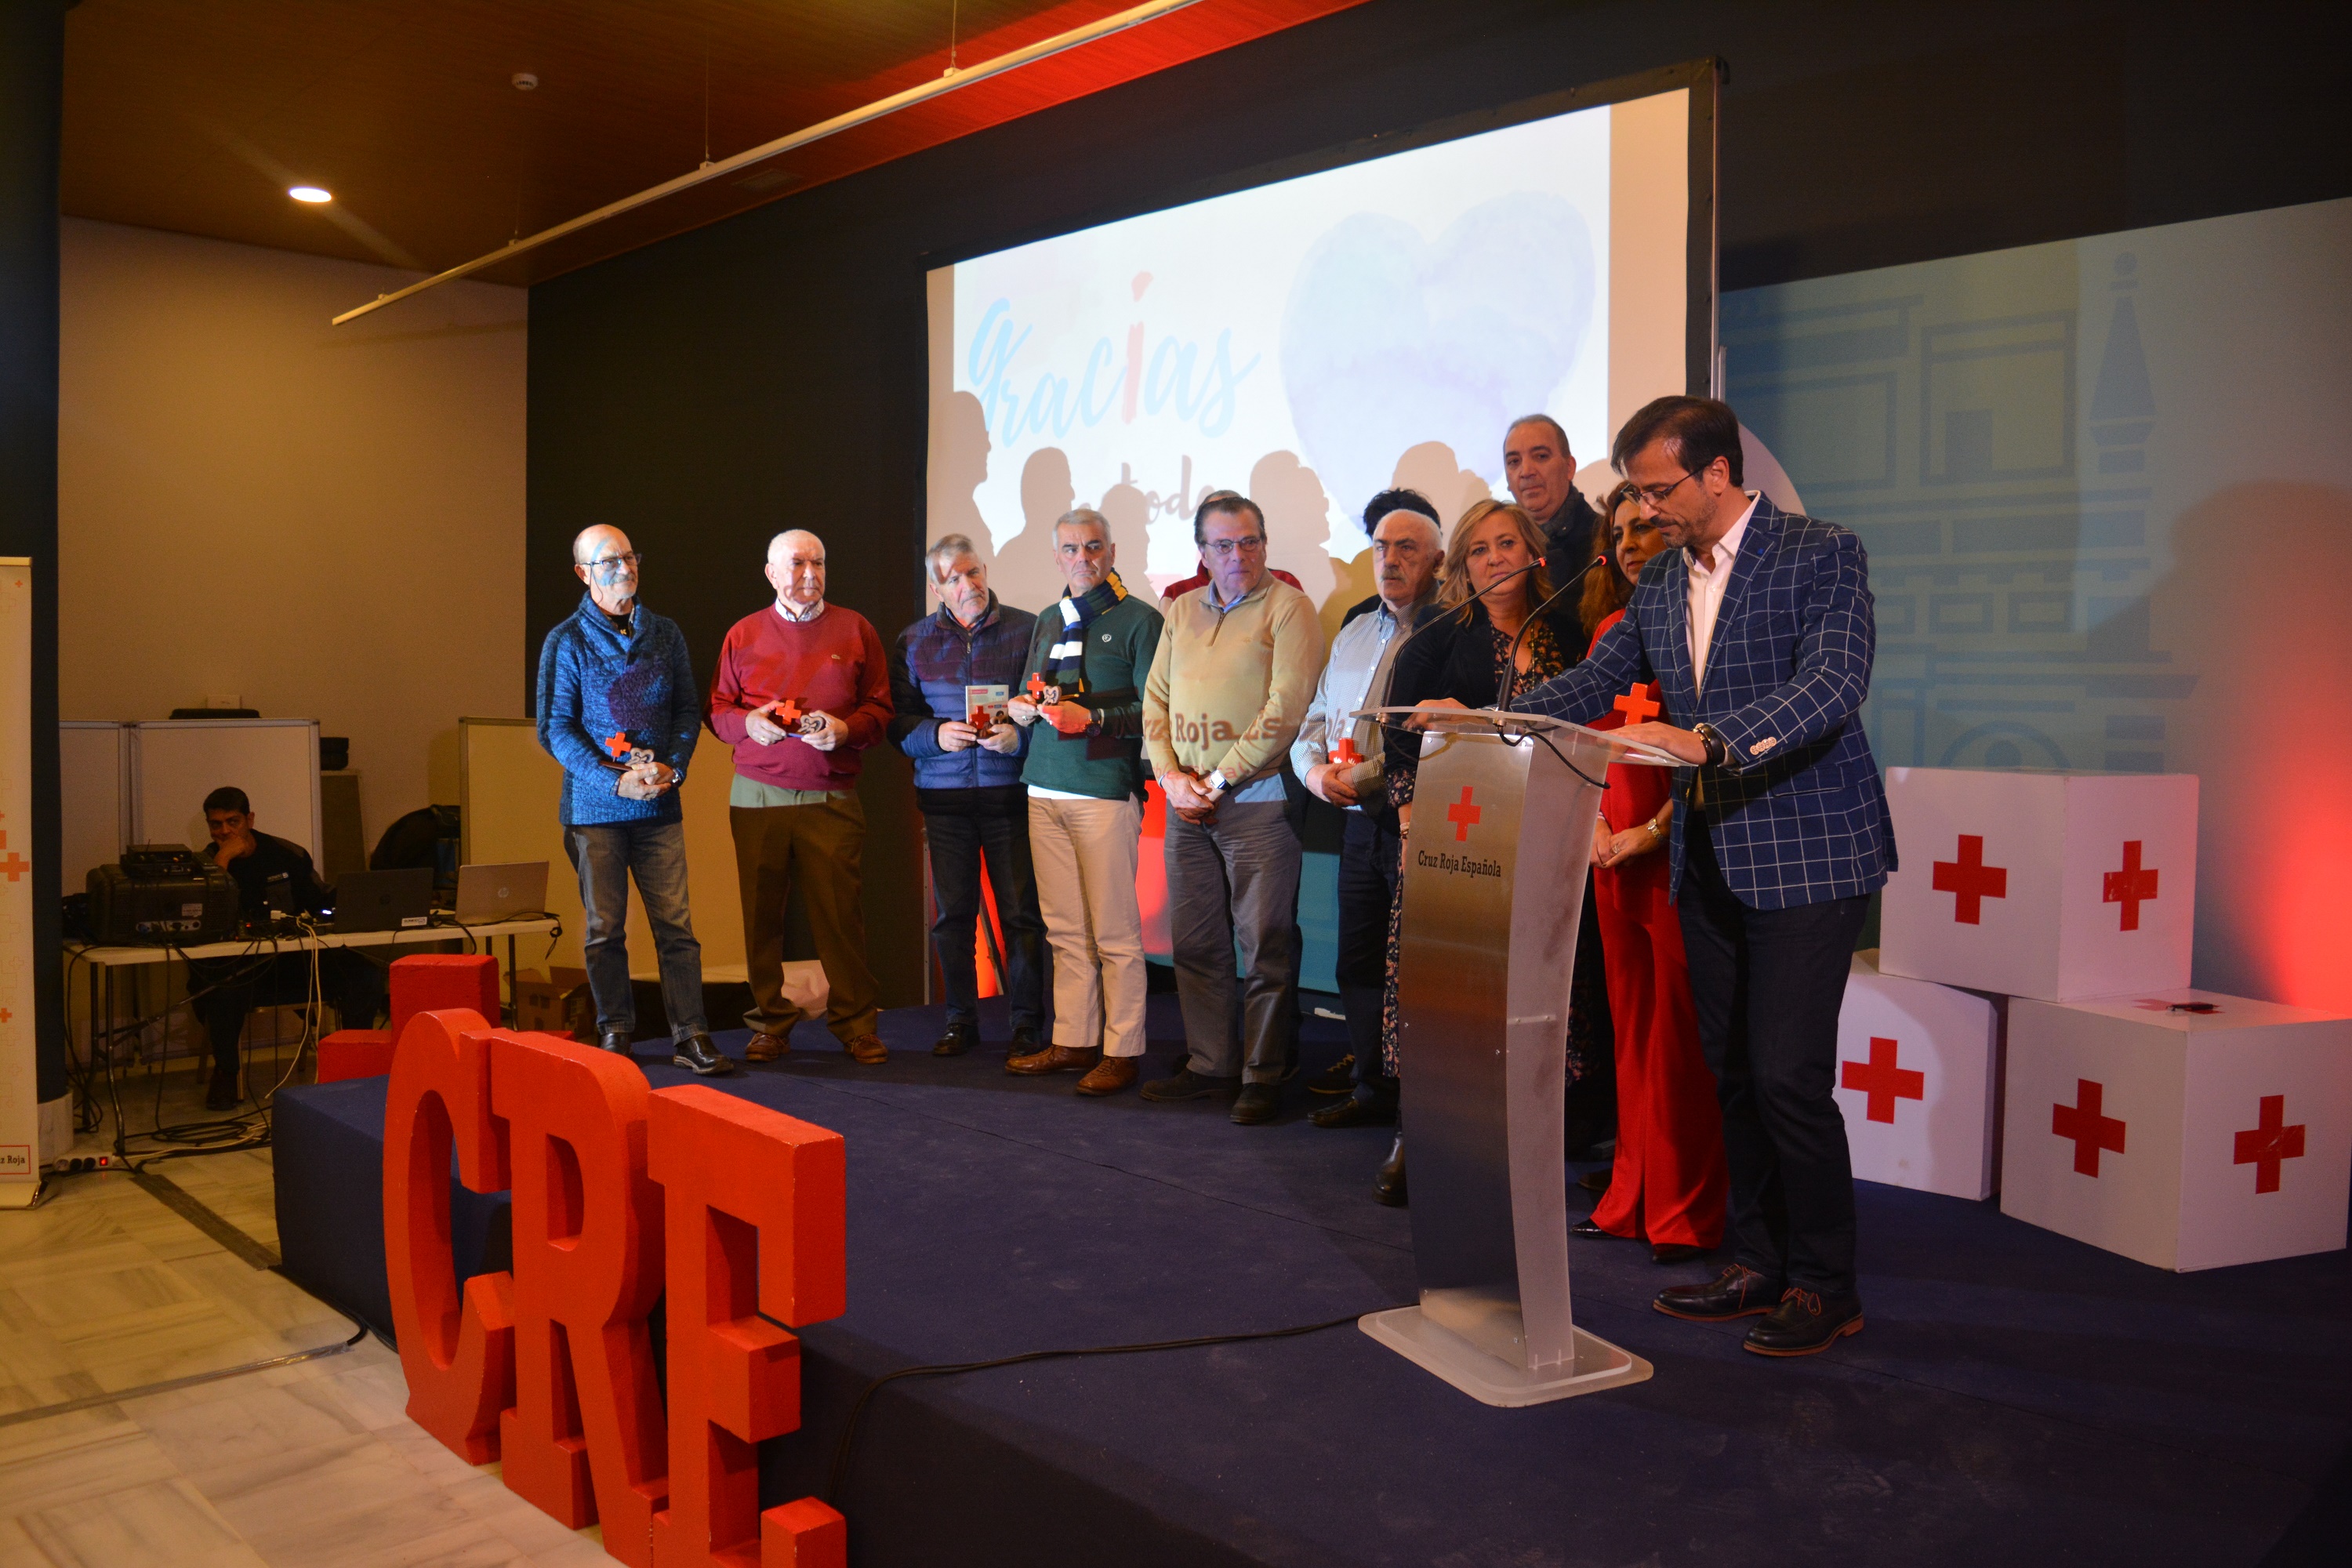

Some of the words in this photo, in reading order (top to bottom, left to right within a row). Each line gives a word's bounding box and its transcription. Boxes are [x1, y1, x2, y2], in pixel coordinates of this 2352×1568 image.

[1175, 713, 1241, 750] Roja
[1418, 850, 1438, 868] Cruz
[1439, 853, 1459, 874] Roja
[1461, 856, 1501, 878] Española
[7, 1155, 25, 1166] Roja
[383, 1008, 847, 1568] CRE
